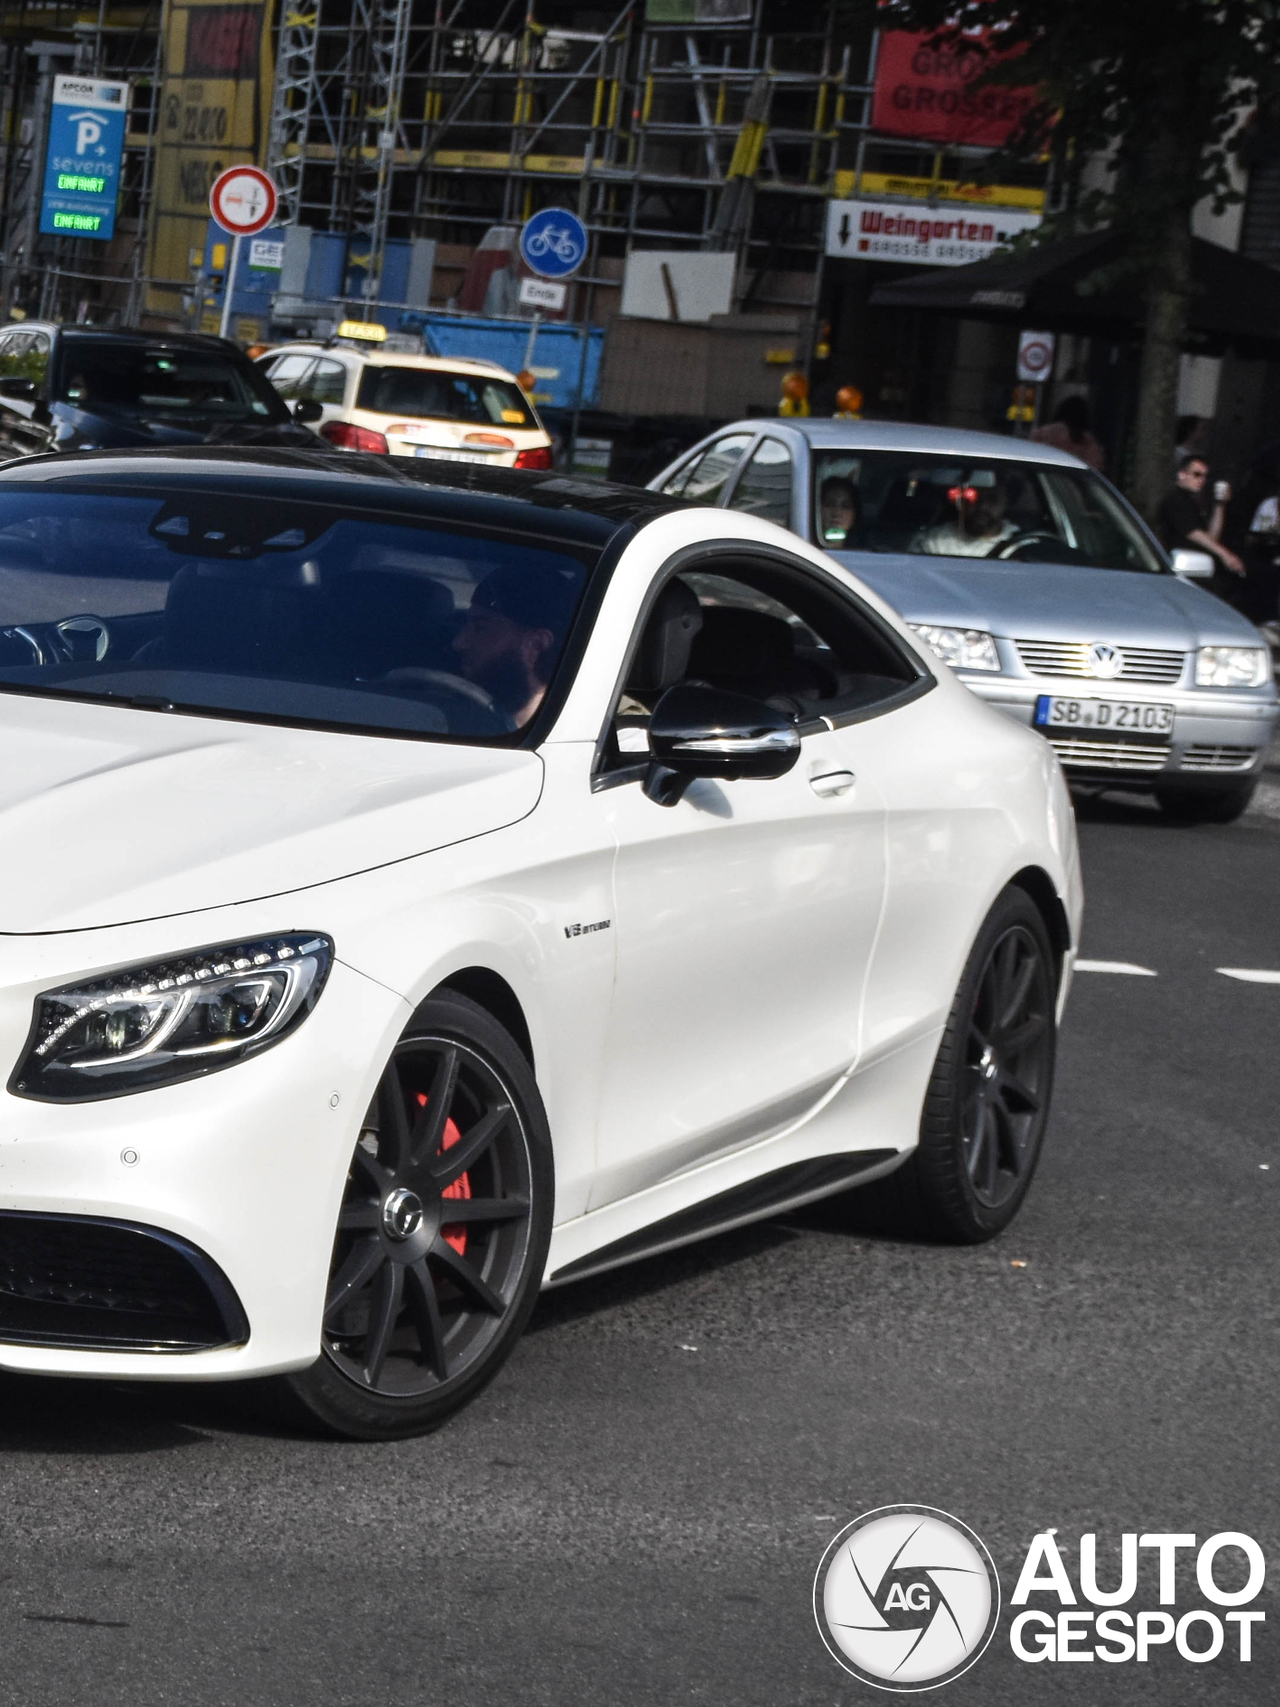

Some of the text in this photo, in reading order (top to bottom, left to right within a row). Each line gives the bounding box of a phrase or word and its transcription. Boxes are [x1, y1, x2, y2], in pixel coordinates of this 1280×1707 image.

[52, 156, 115, 176] sevens
[57, 174, 105, 193] EINFAHRT
[53, 213, 101, 232] EINFAHRT
[526, 286, 556, 300] Ende
[1052, 700, 1173, 729] SB D 2103
